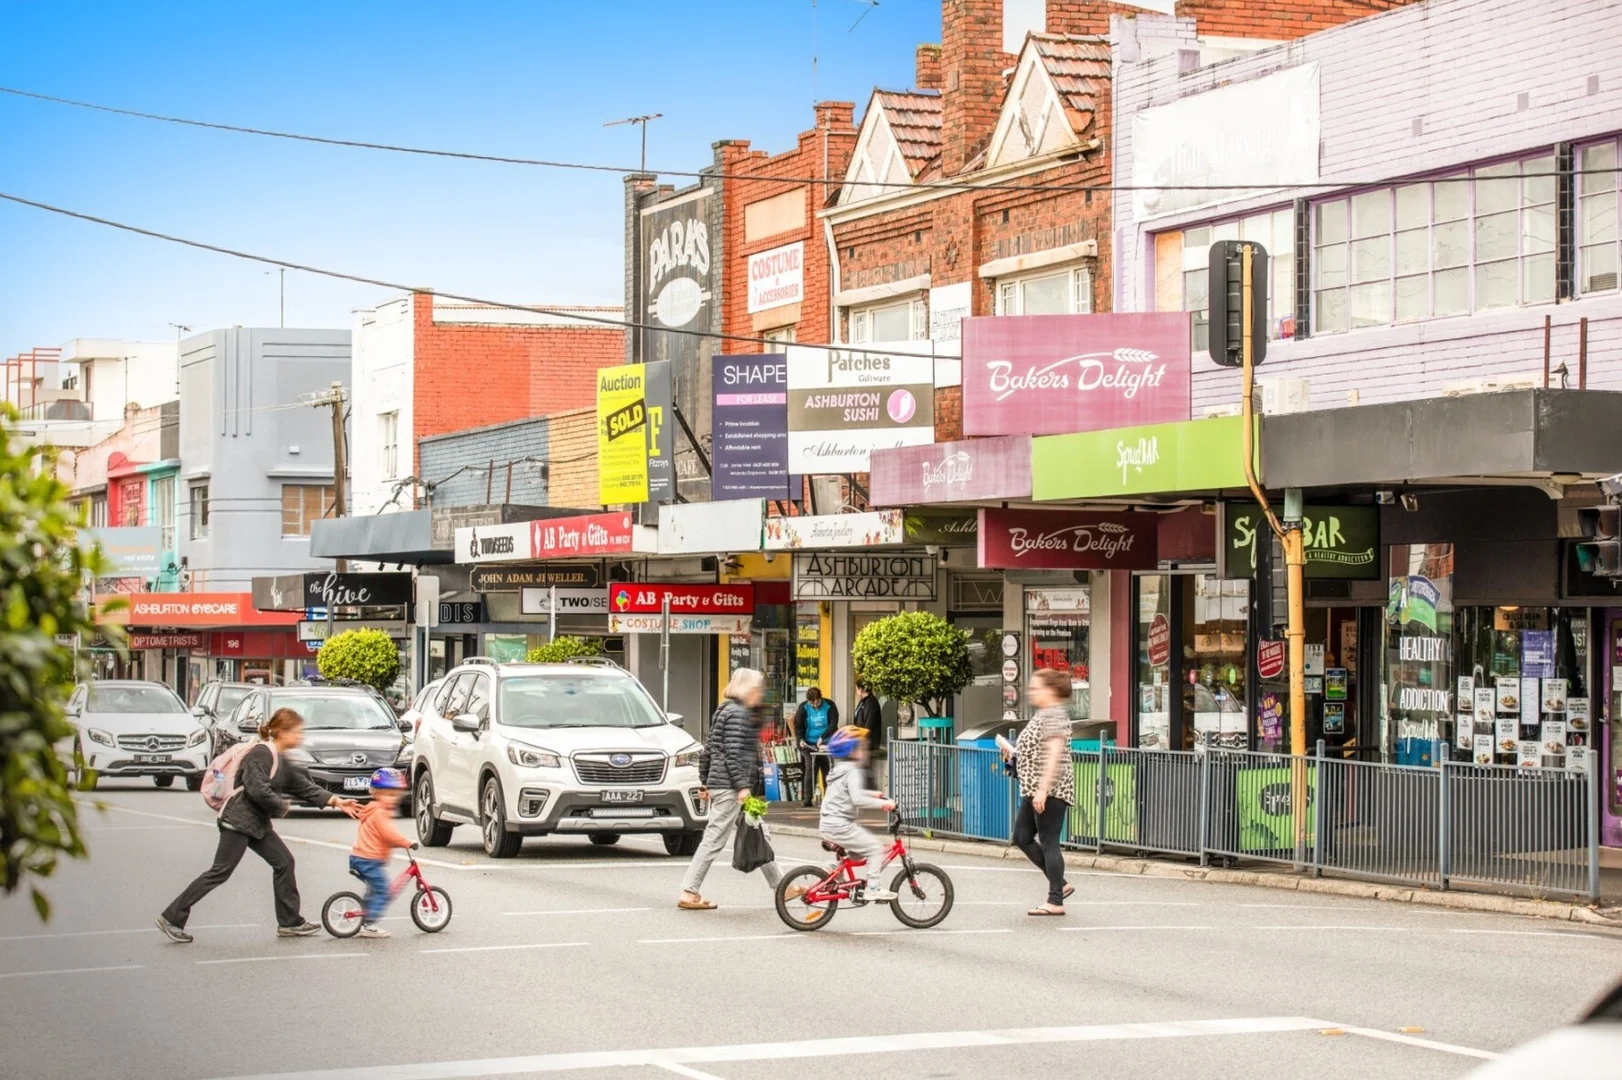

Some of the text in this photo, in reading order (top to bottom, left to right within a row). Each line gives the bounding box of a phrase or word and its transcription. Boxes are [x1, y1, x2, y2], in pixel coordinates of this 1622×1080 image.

[752, 249, 799, 281] COSTUME
[758, 284, 799, 306] ACCESSORIES
[600, 374, 641, 392] Auction
[723, 364, 787, 385] SHAPE
[986, 359, 1166, 401] Bakers Delight
[804, 393, 881, 409] ASHBURTON
[609, 404, 644, 437] SOLD
[843, 408, 879, 422] SUSHI
[558, 525, 580, 552] Party
[587, 523, 608, 547] Gifts
[1008, 527, 1135, 559] Bakers Delight
[806, 553, 924, 577] ASHBURTON
[309, 581, 322, 593] the
[321, 573, 372, 605] hive
[478, 573, 503, 583] JOHN
[506, 573, 533, 584] ADAM
[830, 577, 900, 597] ARCADE
[133, 603, 190, 615] ASHBURTON
[635, 592, 656, 605] AB
[664, 592, 700, 608] Party
[713, 593, 744, 606] Gifts
[626, 618, 711, 630] COSTUE SHOP
[133, 636, 198, 647] OPTOMETRISTS
[227, 640, 239, 648] 196
[1400, 637, 1441, 662] HEALTHY
[1400, 688, 1448, 711] ADDICTION
